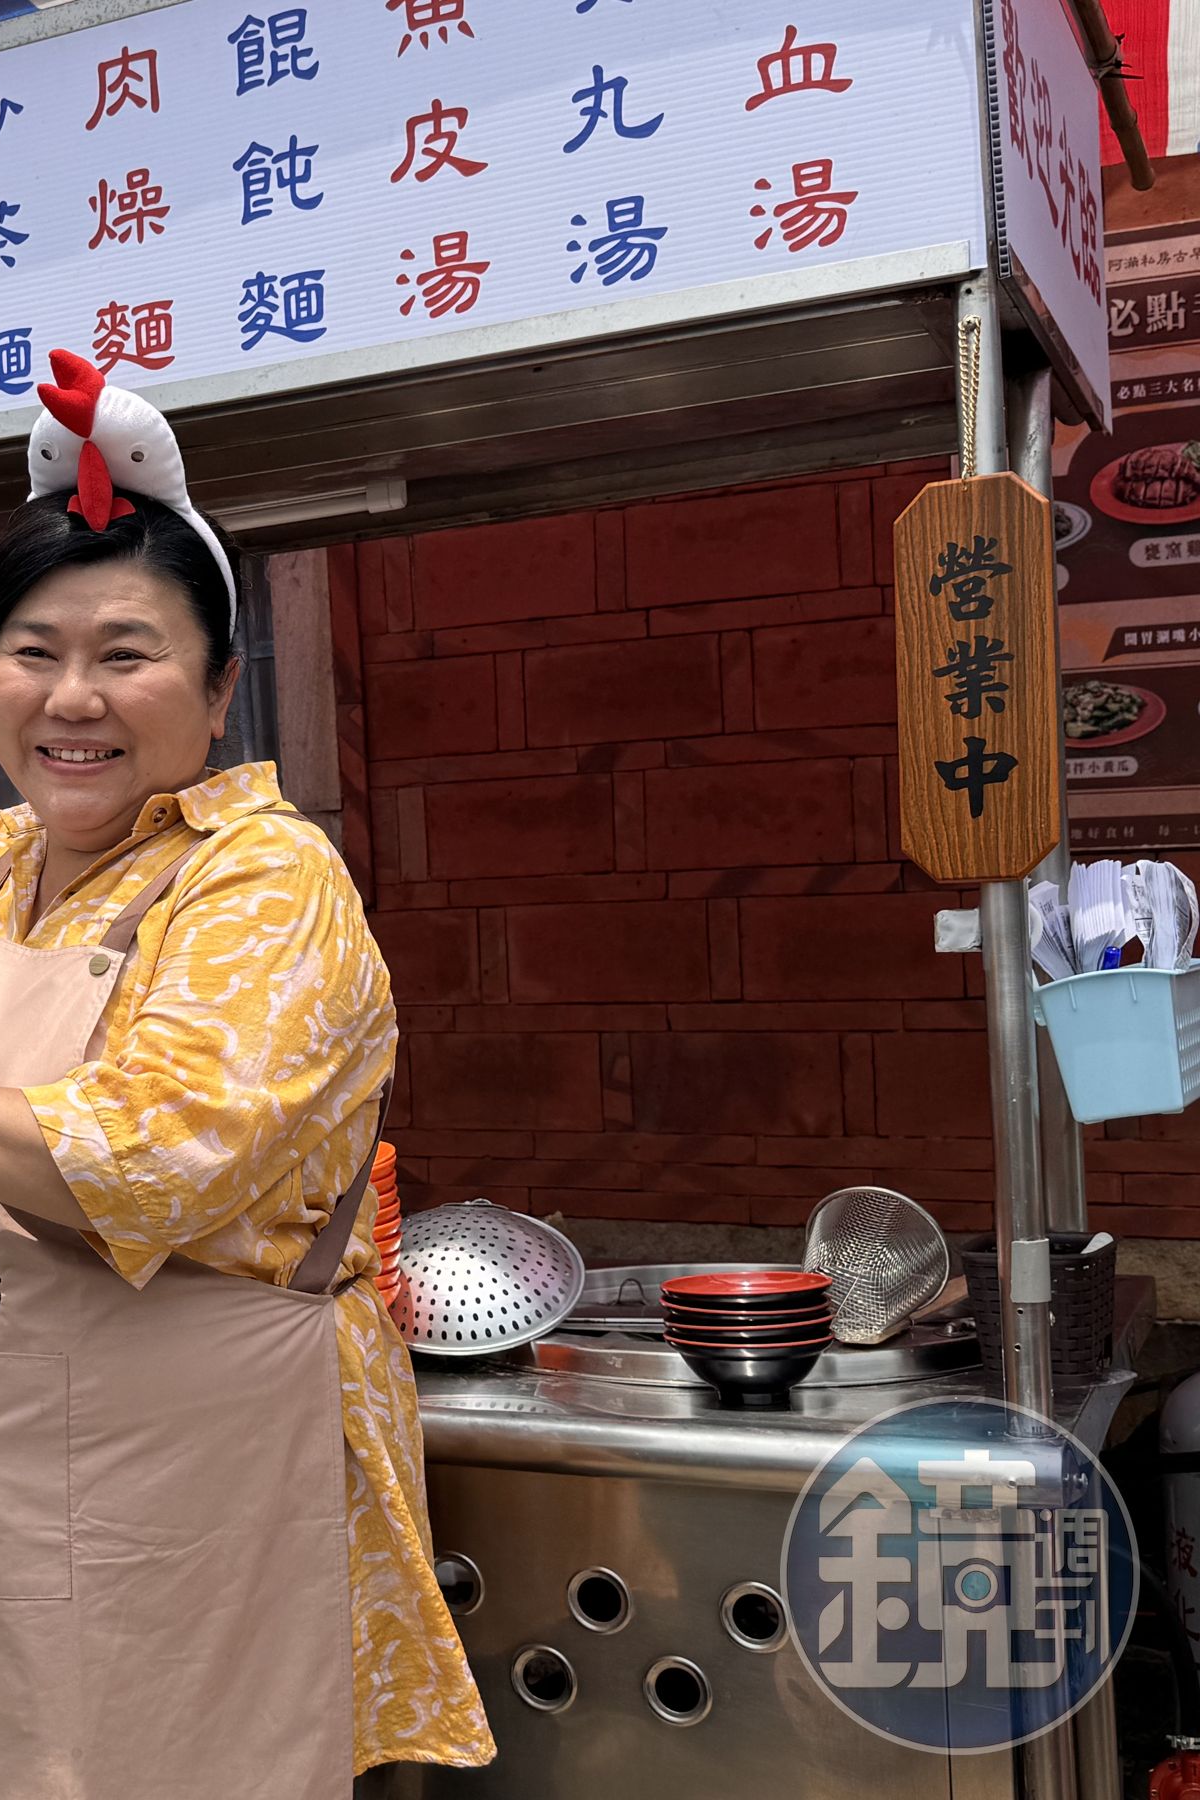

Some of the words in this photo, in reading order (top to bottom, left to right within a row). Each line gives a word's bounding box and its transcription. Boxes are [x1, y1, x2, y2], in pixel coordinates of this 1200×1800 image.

[227, 8, 327, 351] 餛飩麵
[563, 0, 669, 286] 丸湯
[1001, 0, 1101, 309] 歡迎光臨
[1107, 287, 1200, 337] 必點
[1117, 376, 1200, 400] 必點三大名
[930, 535, 1019, 819] 營業中
[1067, 760, 1129, 775] 拌小黃瓜
